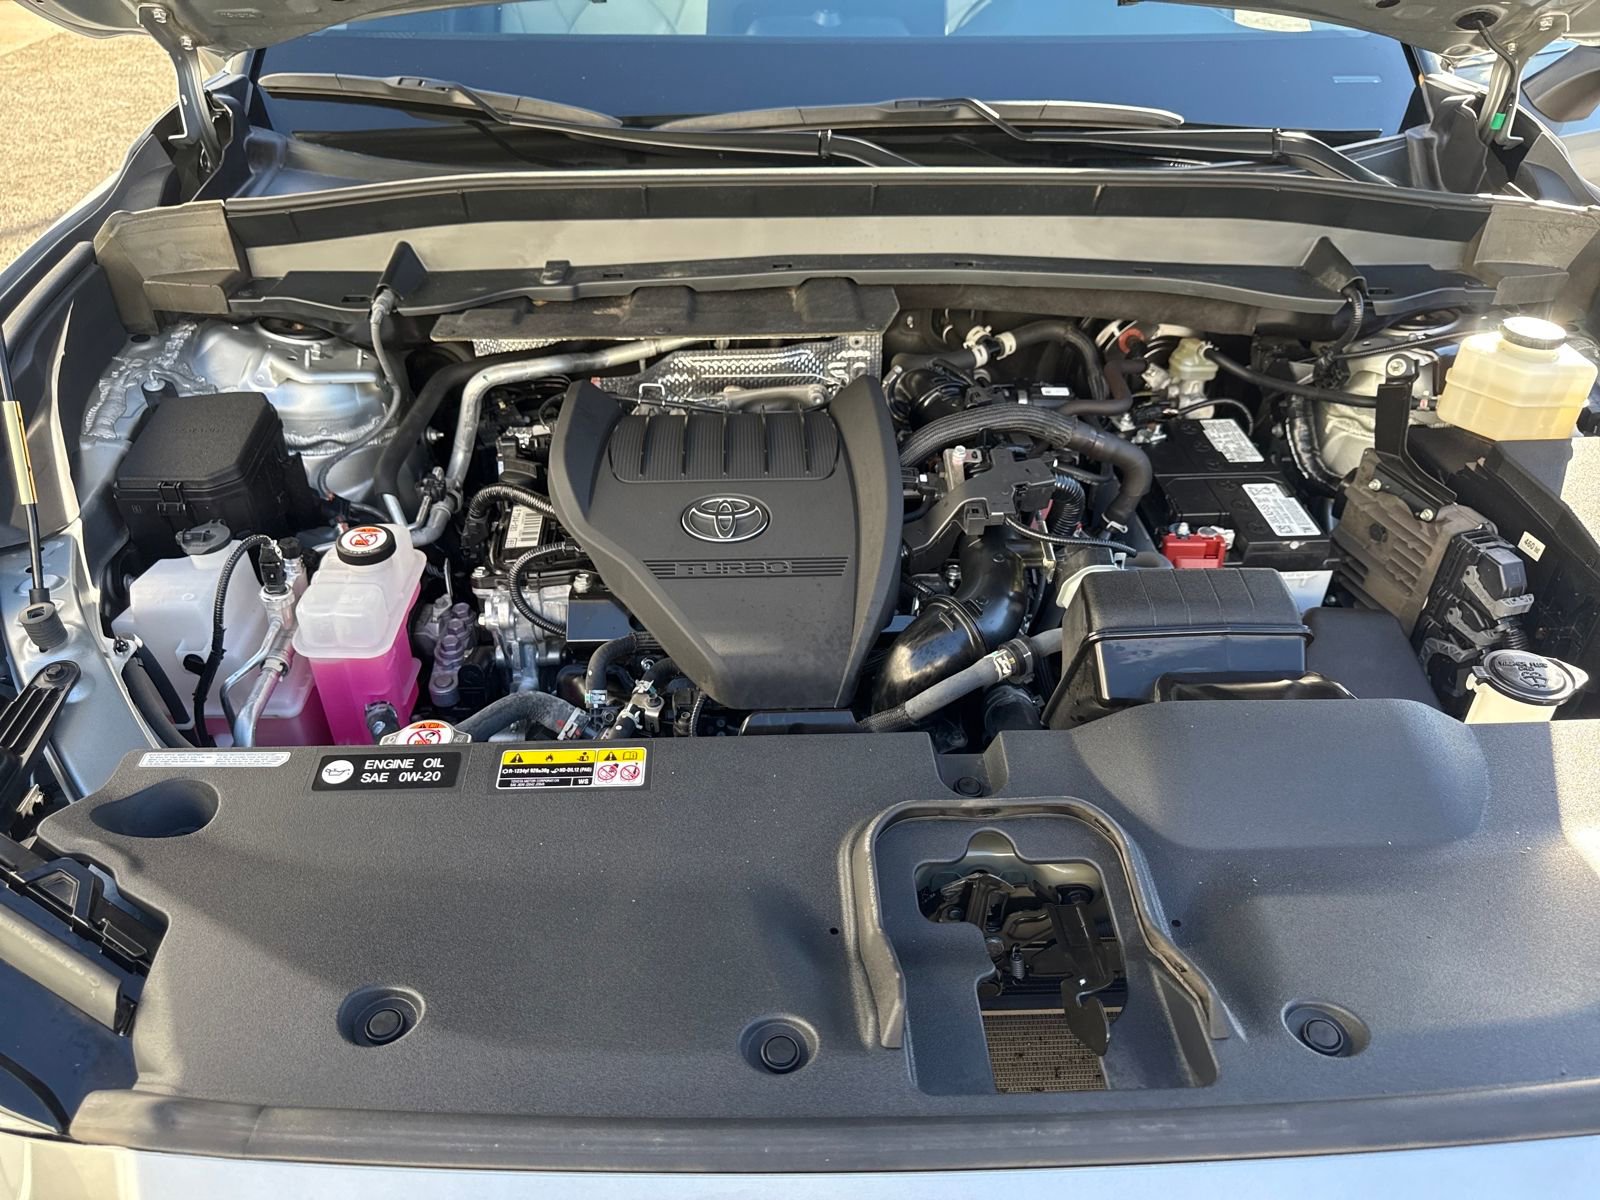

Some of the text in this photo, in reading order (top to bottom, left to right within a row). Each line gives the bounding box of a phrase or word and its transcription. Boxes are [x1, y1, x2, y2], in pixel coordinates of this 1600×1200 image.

[676, 560, 790, 577] TURBO
[364, 758, 445, 770] ENGINE OIL
[360, 771, 441, 783] SAE 0W-20
